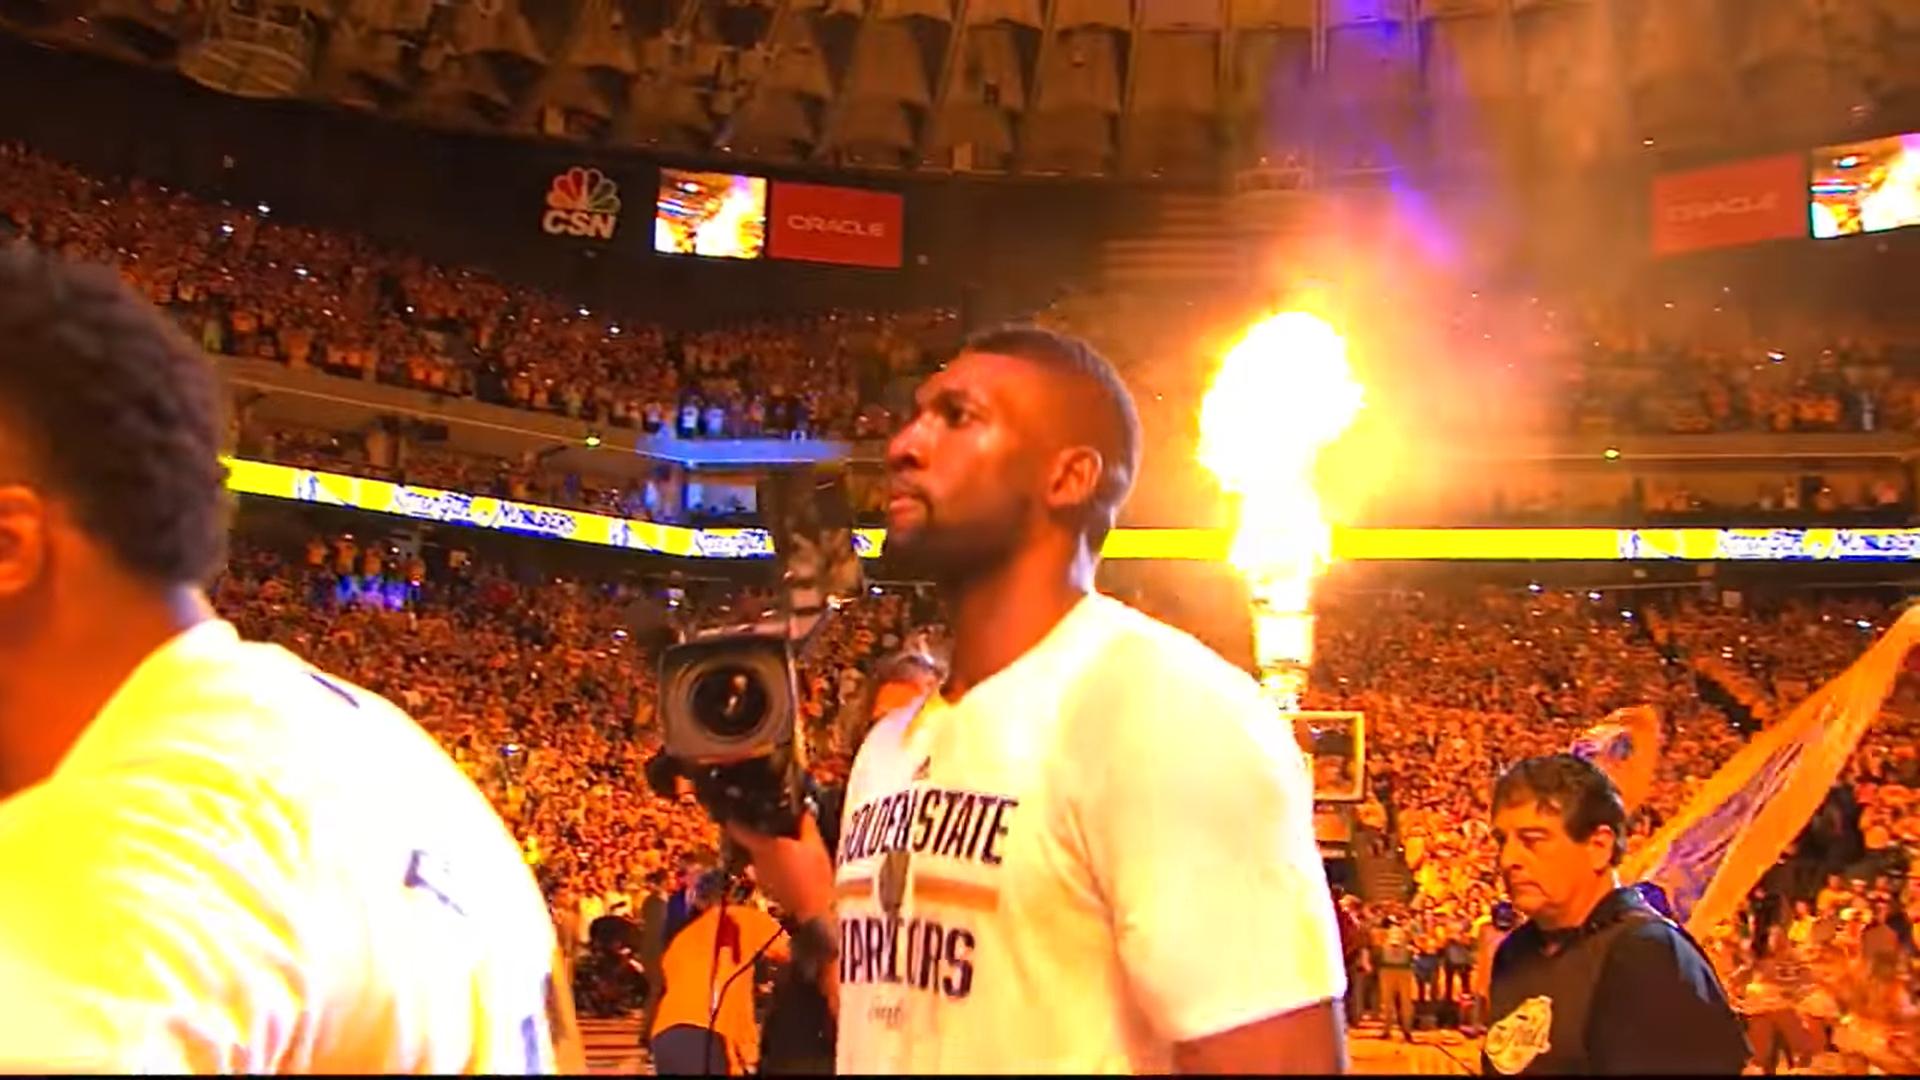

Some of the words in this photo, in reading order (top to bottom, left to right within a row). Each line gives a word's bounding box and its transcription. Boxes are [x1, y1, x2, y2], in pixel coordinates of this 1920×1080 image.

[543, 210, 616, 239] CSN
[787, 214, 885, 238] ORACLE
[839, 790, 918, 865] OLDEN
[913, 789, 1019, 865] STATE
